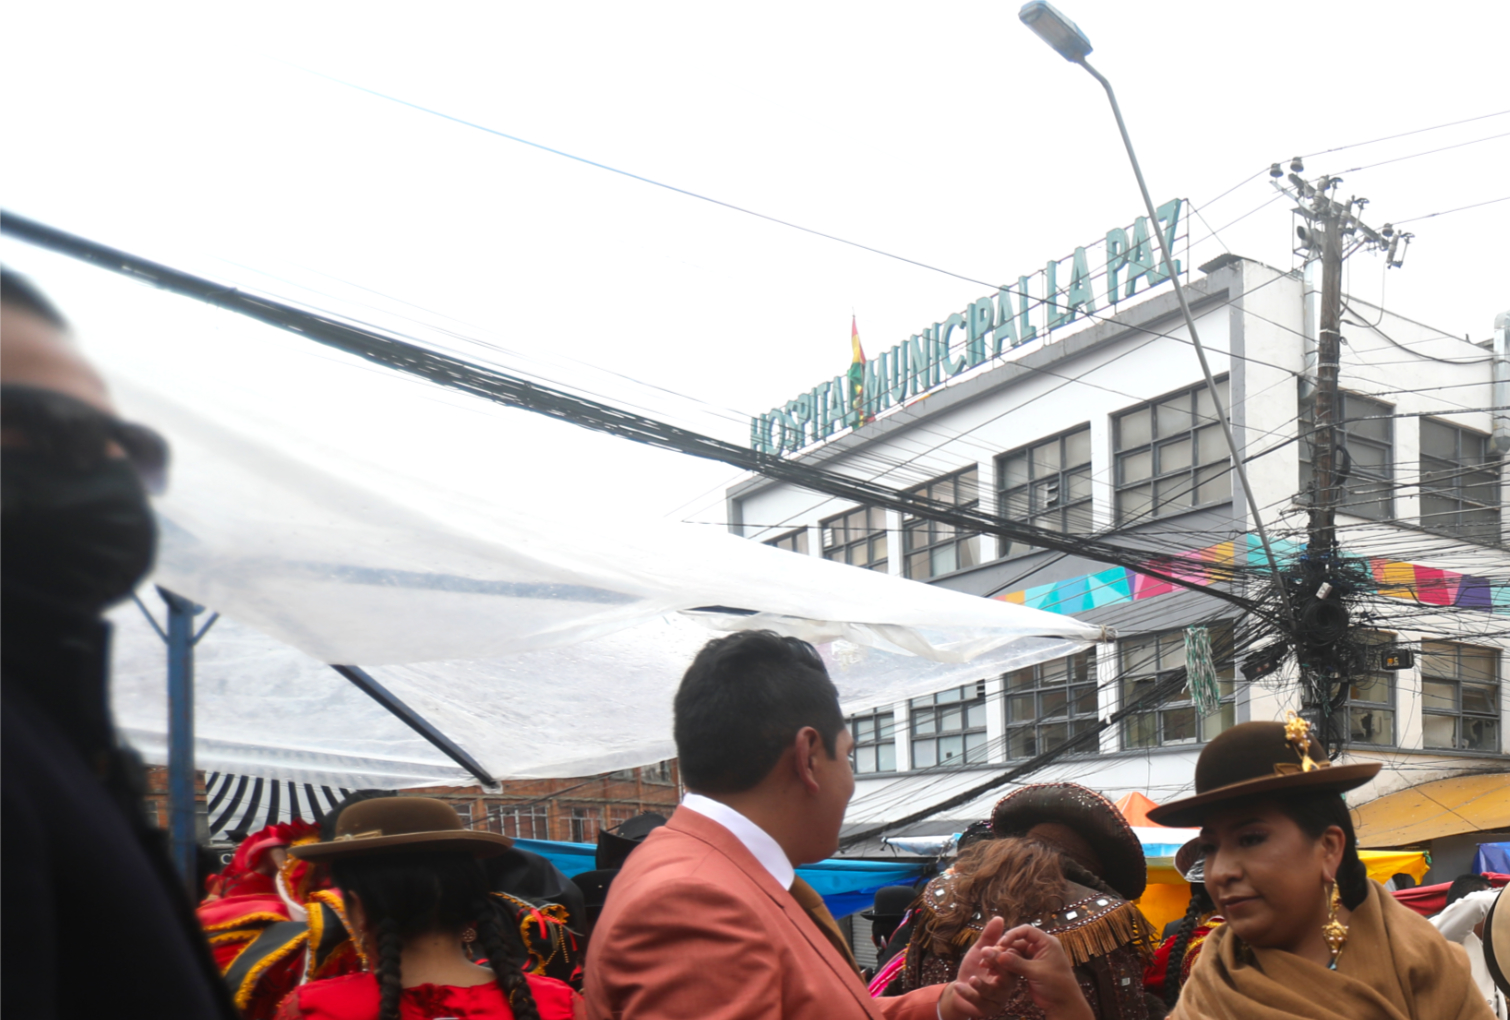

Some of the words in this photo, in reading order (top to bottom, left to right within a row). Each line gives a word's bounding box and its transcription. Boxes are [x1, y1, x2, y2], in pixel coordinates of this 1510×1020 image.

[750, 371, 860, 458] HOSPITAL
[862, 275, 1037, 417] MUNICIPAL
[1047, 246, 1096, 331] LA
[1106, 198, 1183, 303] PAZ
